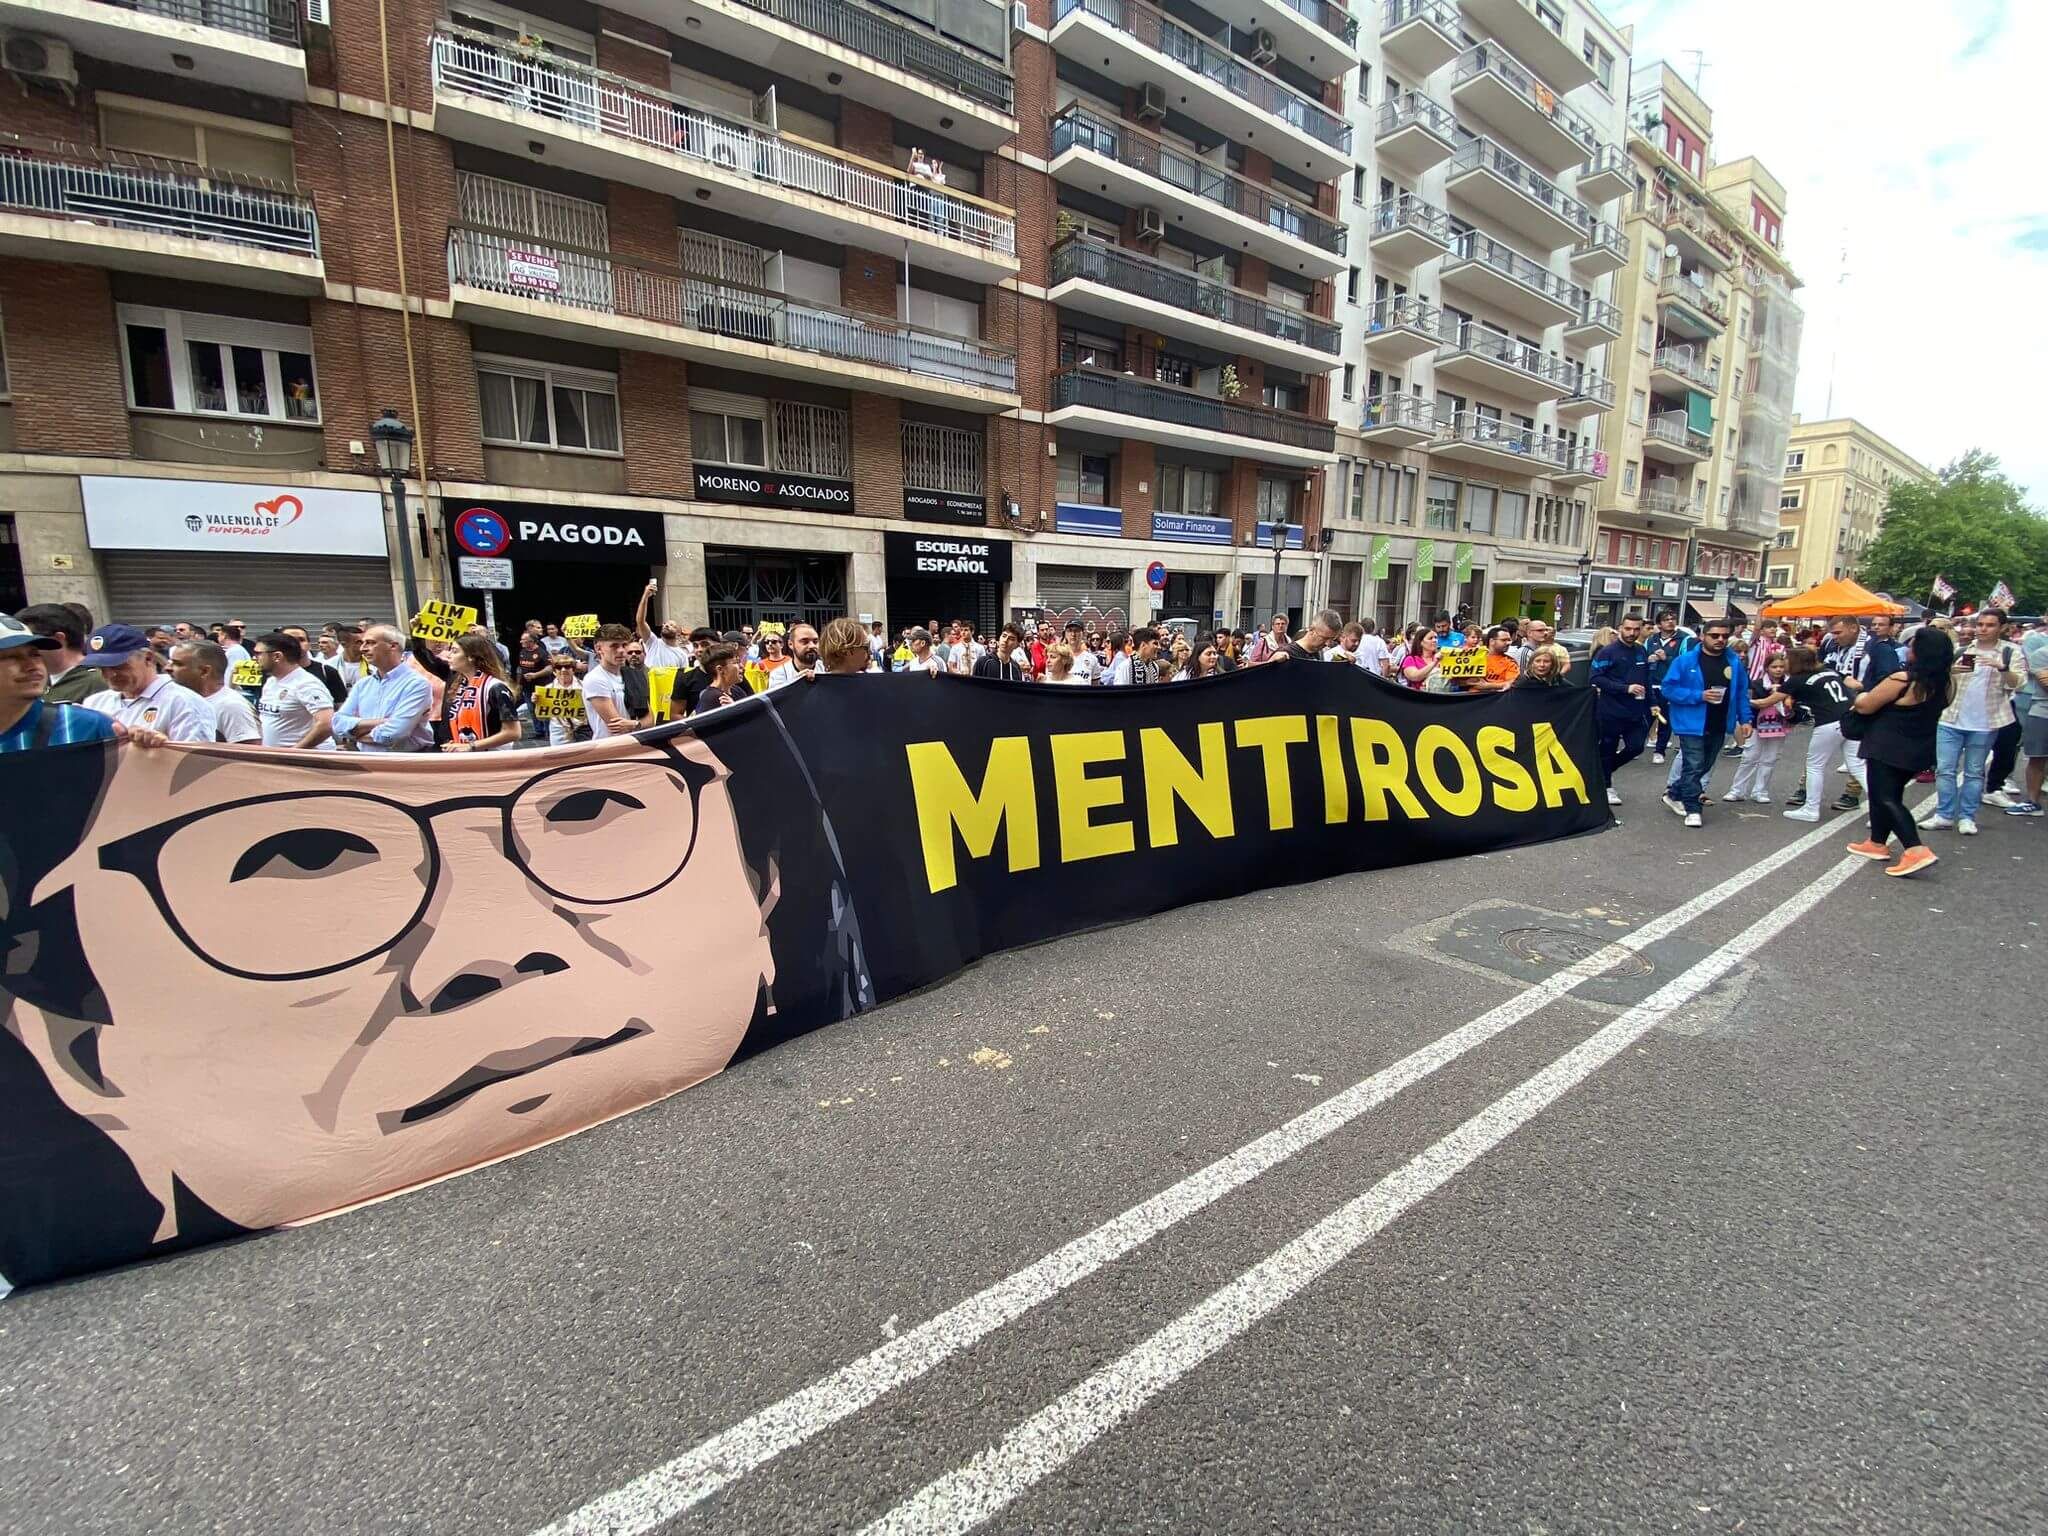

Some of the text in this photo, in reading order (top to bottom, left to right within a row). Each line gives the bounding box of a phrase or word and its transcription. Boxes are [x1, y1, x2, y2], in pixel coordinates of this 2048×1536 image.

[511, 252, 555, 267] SE VENDE
[699, 474, 761, 492] MORENO
[779, 484, 850, 502] ASOCIADOS
[907, 496, 938, 505] ABOGADOS
[946, 500, 982, 510] ECONOMISTAS
[206, 514, 280, 527] VALENCIA CF
[1155, 518, 1216, 533] Solmar Finance
[207, 525, 271, 535] FUNDACIÓ
[519, 521, 645, 547] PAGODA
[915, 541, 989, 556] ESCUELA DE
[917, 556, 989, 574] ESPAÑOL
[428, 602, 465, 619] LIM
[436, 618, 454, 626] GO
[1449, 648, 1479, 657] LIM
[1442, 665, 1485, 675] HOME
[545, 689, 576, 699] LIM
[1824, 680, 1848, 703] 12
[538, 706, 585, 717] HOME
[905, 714, 1590, 894] MENTIROSA
